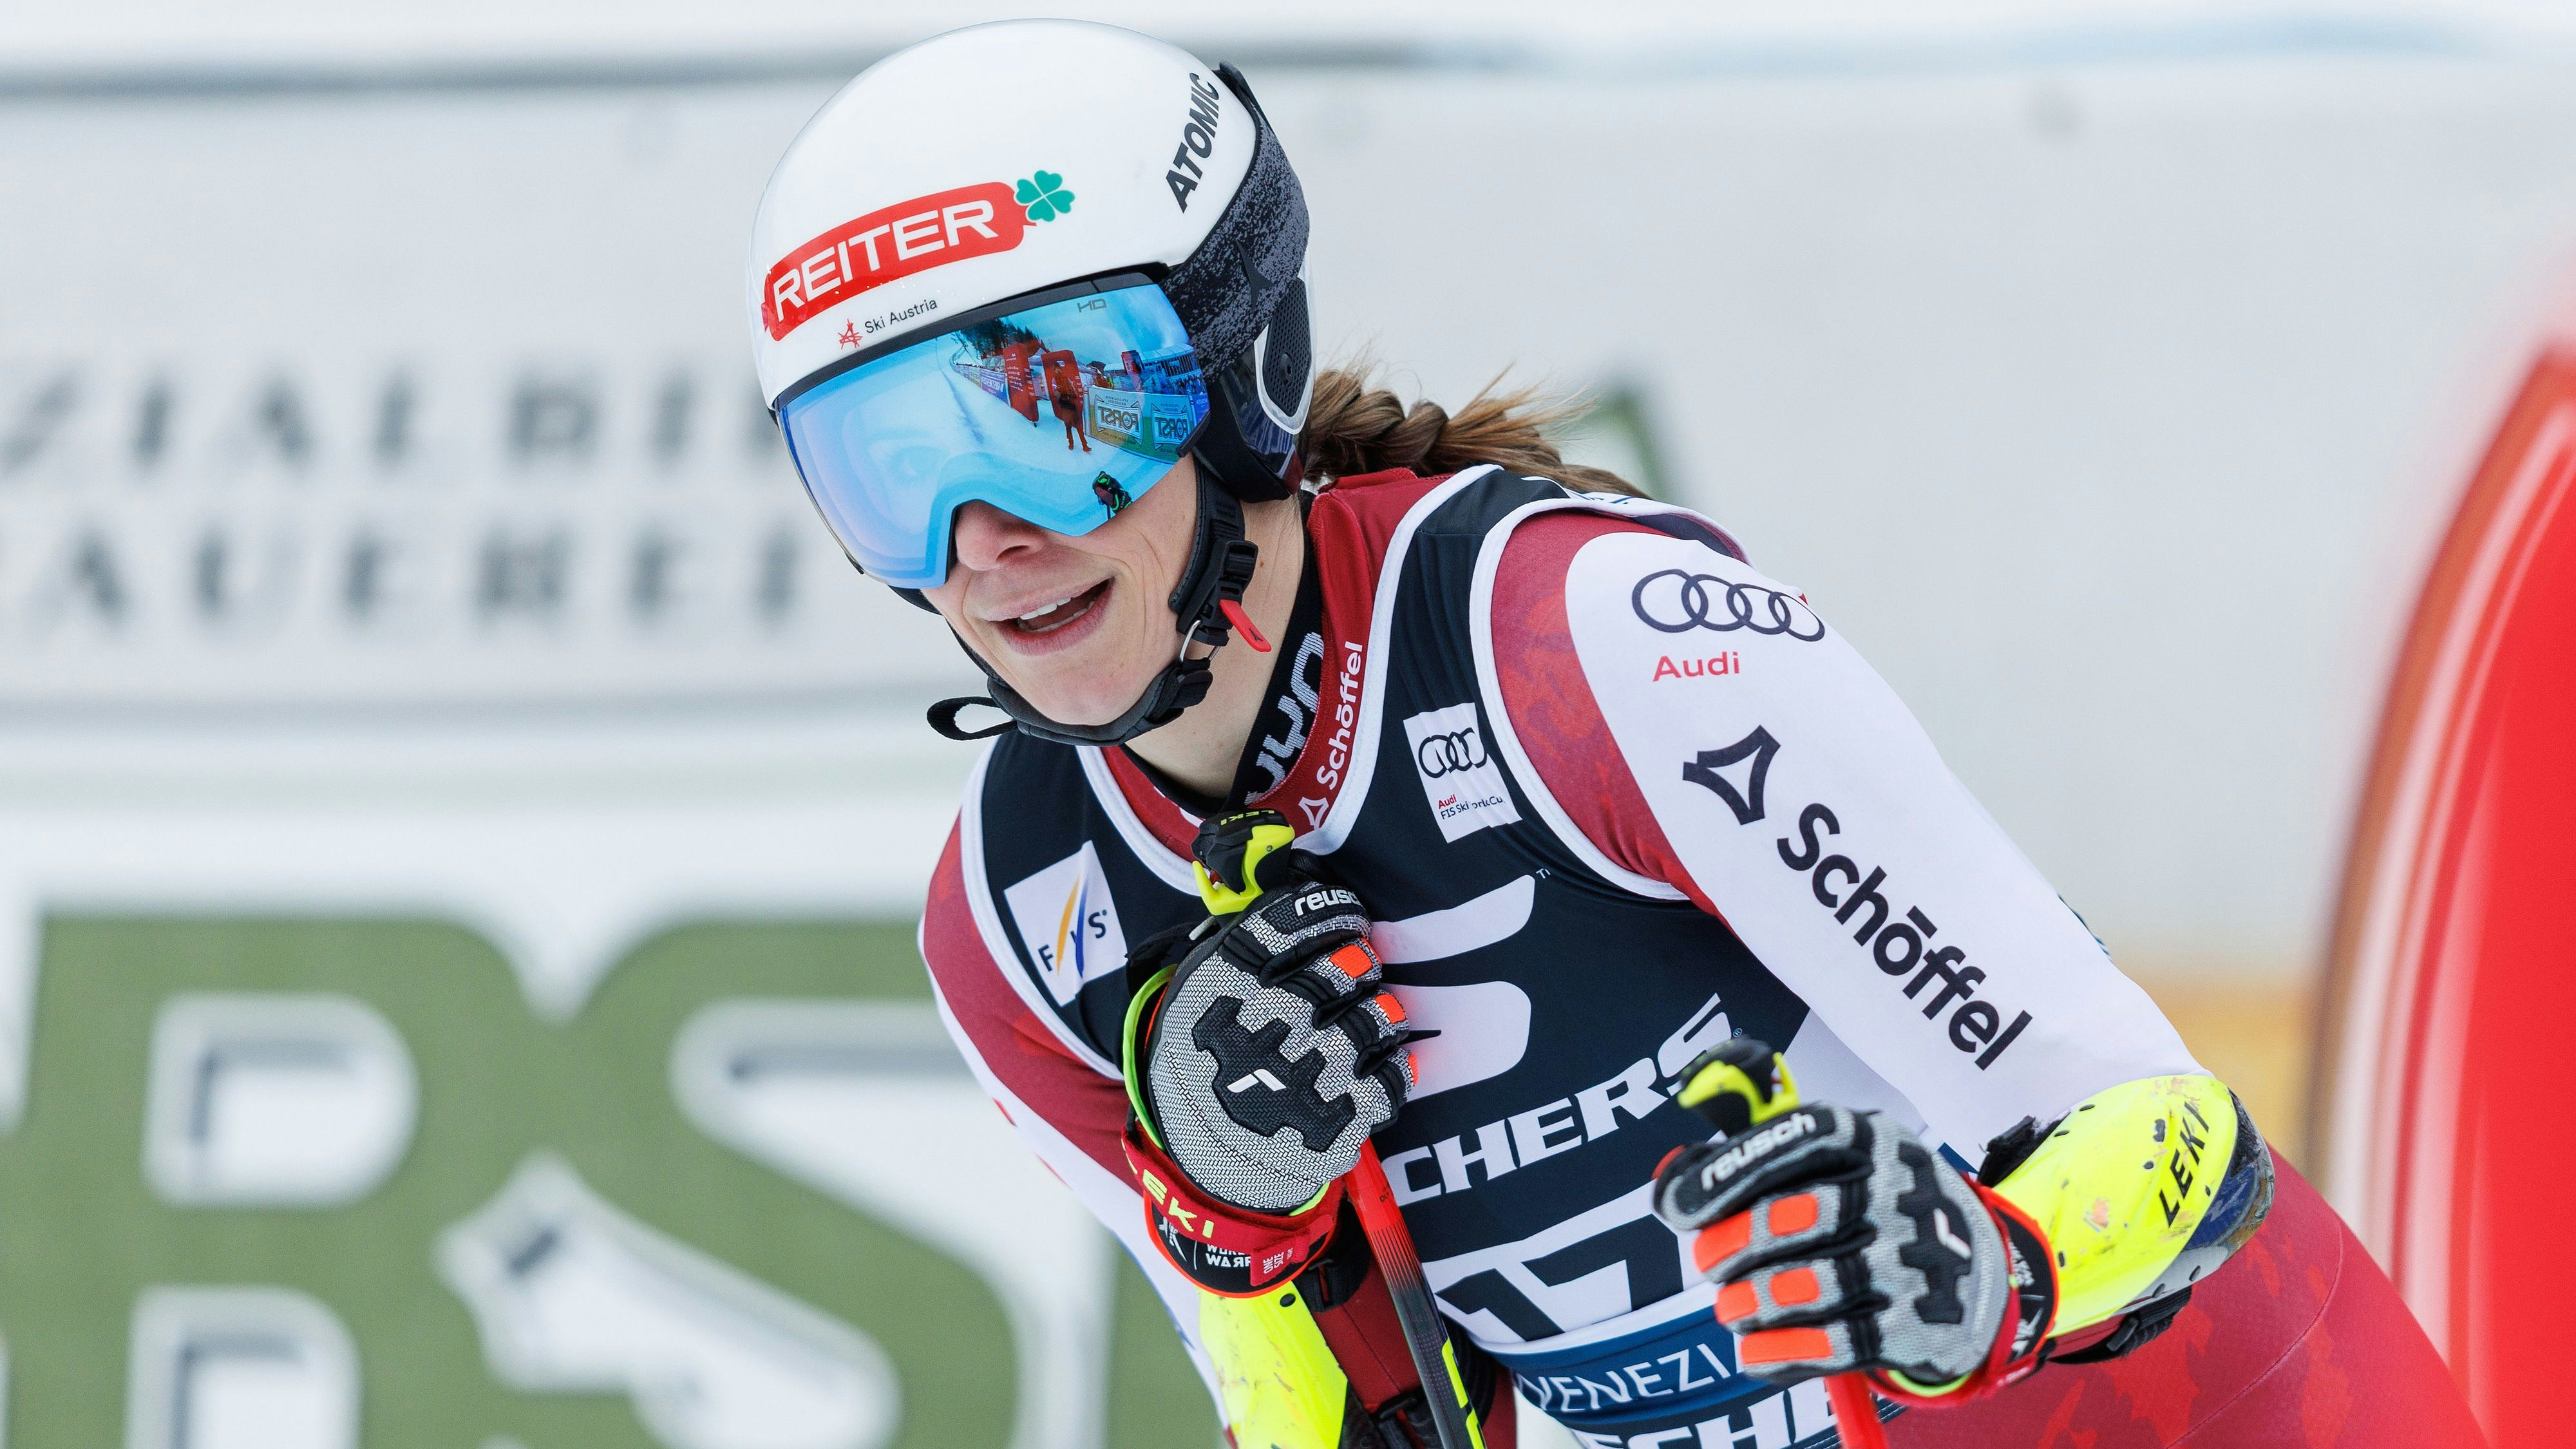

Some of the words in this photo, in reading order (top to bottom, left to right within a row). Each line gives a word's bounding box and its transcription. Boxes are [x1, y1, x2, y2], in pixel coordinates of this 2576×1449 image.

[1166, 72, 1219, 213] ATOMIC
[773, 200, 999, 322] REITER
[865, 316, 886, 334] Ski
[890, 299, 938, 325] Austria
[1077, 298, 1107, 313] HD
[1653, 651, 1740, 682] Audi
[1220, 810, 1275, 826] LEKI
[1438, 793, 1457, 810] Audi
[1441, 807, 1456, 820] FIS
[1456, 801, 1469, 813] Ski
[1489, 796, 1506, 806] Cu
[1701, 1113, 1817, 1191] reusch
[2159, 1101, 2209, 1227] LEKI
[1263, 1256, 1273, 1274] ONE
[1274, 1251, 1284, 1269] SIZE
[1435, 1213, 1684, 1342] 17
[1513, 1331, 1744, 1412] VENEZI
